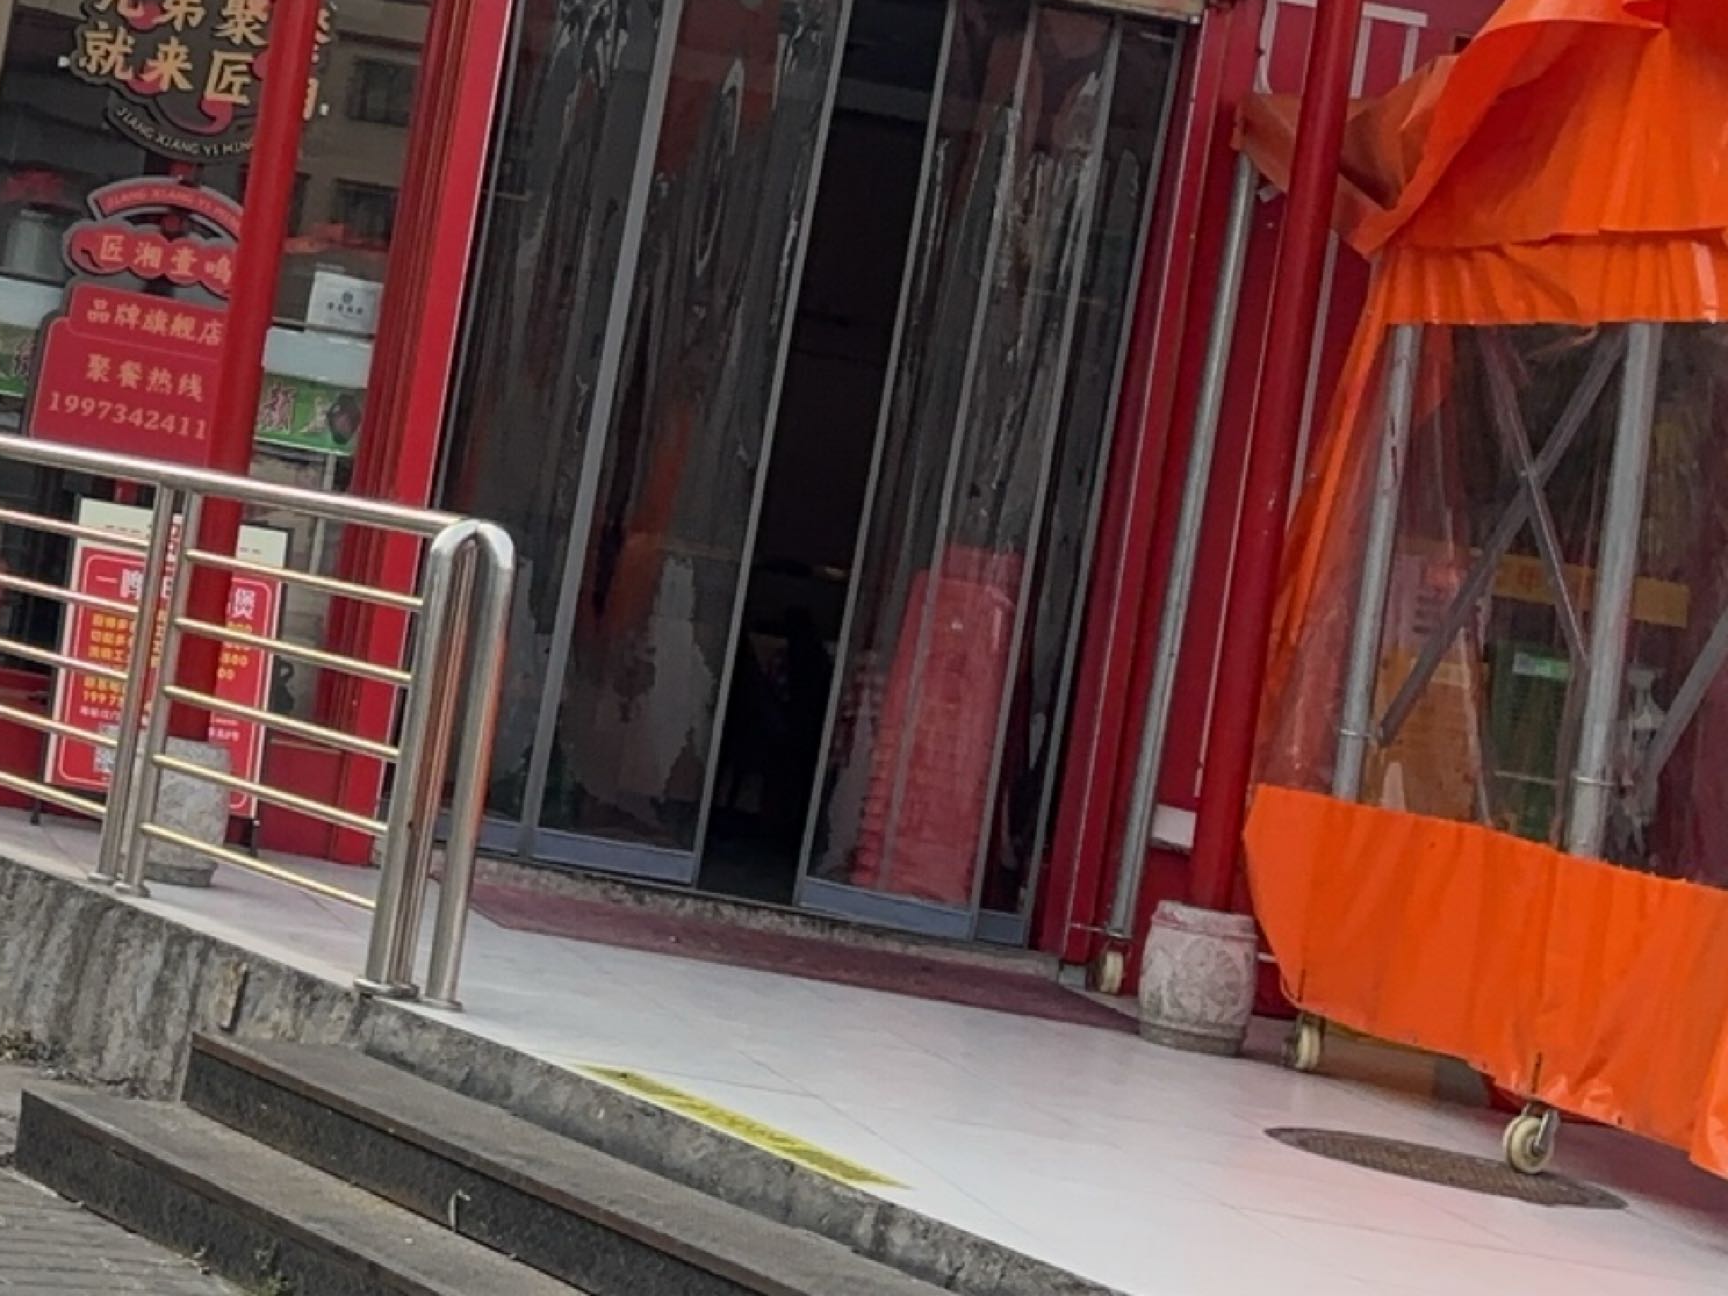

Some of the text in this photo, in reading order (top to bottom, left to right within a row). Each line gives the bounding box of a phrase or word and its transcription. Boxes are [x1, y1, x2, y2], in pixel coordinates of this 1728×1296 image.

[87, 299, 224, 346] 品牌旗舰店
[86, 353, 204, 402] 聚餐热线
